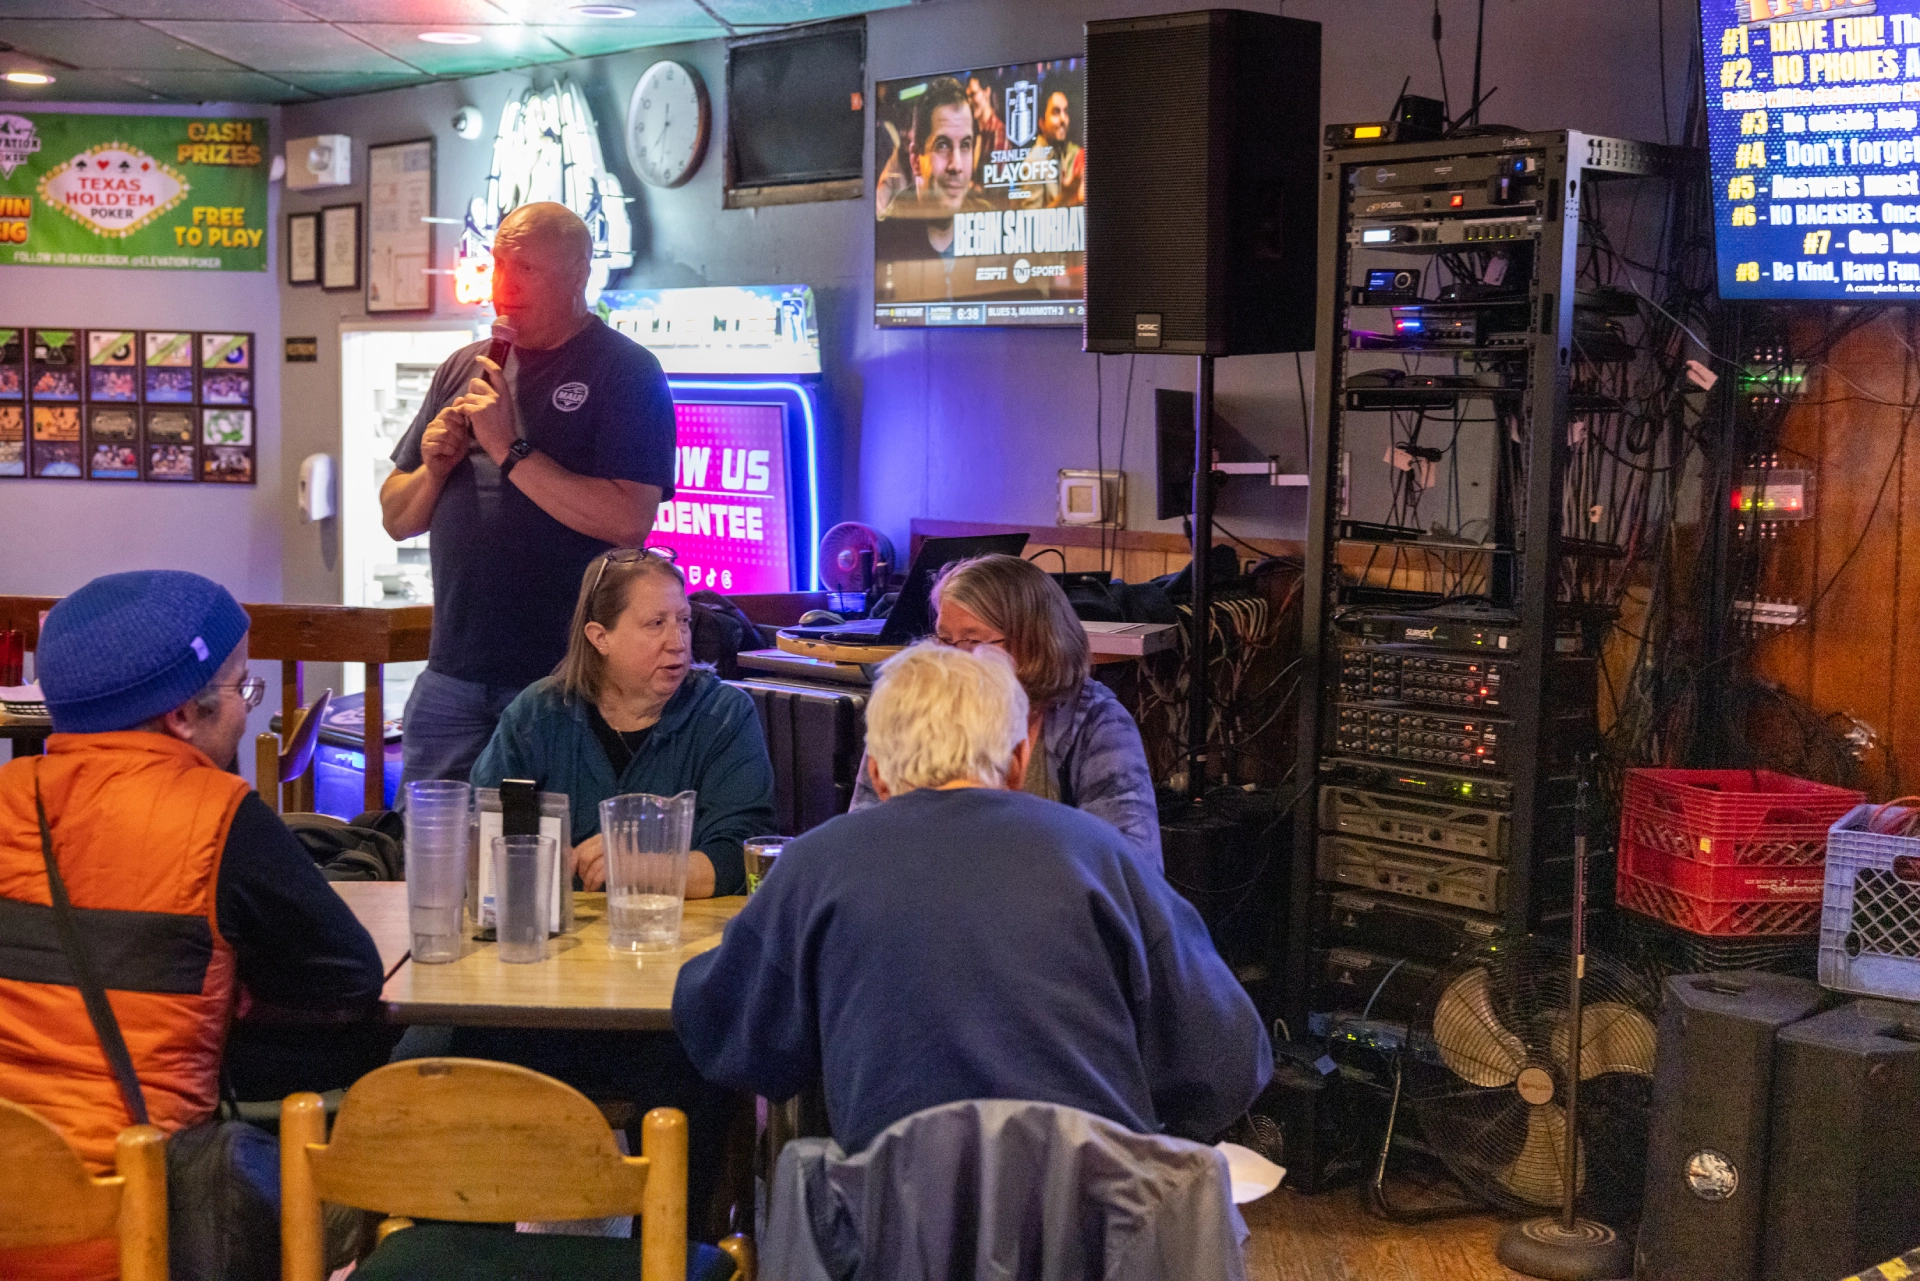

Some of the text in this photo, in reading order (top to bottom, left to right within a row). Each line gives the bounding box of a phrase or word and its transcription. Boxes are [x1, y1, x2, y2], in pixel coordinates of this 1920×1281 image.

[1721, 25, 1749, 55] #1
[1769, 20, 1828, 52] HAVE
[1833, 16, 1885, 48] FUN!
[1720, 58, 1752, 88] #2
[1773, 54, 1804, 85] NO
[1809, 49, 1900, 83] PHONES
[1723, 89, 1766, 110] Points
[1793, 88, 1812, 107] be
[1812, 85, 1880, 106] deducted
[187, 122, 252, 142] CASH
[1740, 110, 1768, 135] #3
[177, 144, 261, 165] PRIZES
[991, 148, 1031, 163] STANLEY
[1735, 141, 1766, 169] #4
[1785, 138, 1845, 167] Don't
[984, 160, 1058, 184] PLAYOFFS
[78, 177, 141, 191] TEXAS
[1728, 175, 1755, 200] #5
[1772, 174, 1860, 198] Answers
[65, 192, 154, 206] HOLD'EM
[91, 208, 134, 218] POKER
[192, 206, 245, 227] FREE
[1731, 205, 1757, 226] #6
[1769, 204, 1793, 225] NO
[1795, 203, 1878, 225] BACKSIES.
[0, 221, 27, 243] IG
[174, 226, 263, 247] TO PLAY
[954, 211, 1002, 256] BEGIN
[1803, 230, 1831, 254] #7
[976, 267, 1007, 280] ESPN
[1031, 265, 1066, 277] SPORTS
[1736, 261, 1759, 282] #8
[1772, 261, 1794, 281] Be
[1797, 261, 1840, 283] Kind,
[1842, 261, 1885, 281] Have
[1854, 284, 1899, 294] complete
[957, 307, 979, 320] 6:38
[988, 307, 1010, 316] BLUES
[1018, 306, 1056, 316] MAMMOTH
[722, 448, 770, 491] US
[652, 501, 764, 540] DENTEE
